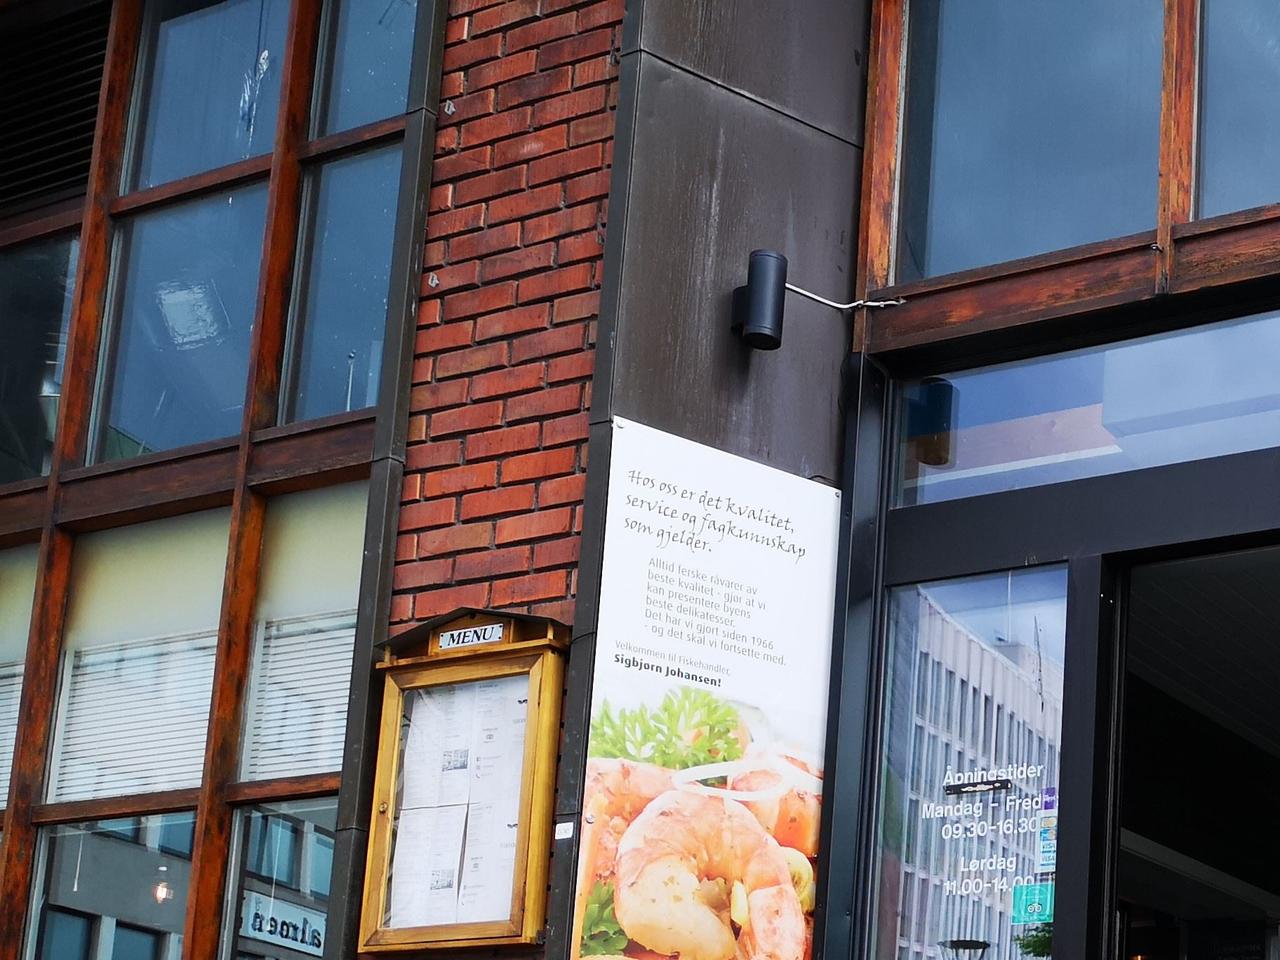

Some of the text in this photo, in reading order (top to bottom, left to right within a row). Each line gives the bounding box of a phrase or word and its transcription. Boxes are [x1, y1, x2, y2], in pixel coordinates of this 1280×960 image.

[628, 470, 794, 534] Hos oss er det kvalitet,
[624, 517, 712, 554] som gjelder.
[626, 494, 806, 565] service og fagkunnskap
[648, 570, 675, 586] beste
[678, 580, 714, 597] kvalitet
[758, 600, 766, 610] vi
[649, 558, 675, 573] Alltid
[746, 585, 758, 595] av
[646, 582, 752, 619] kan presentere byens
[646, 595, 673, 611] beste
[448, 627, 494, 646] MENU
[644, 608, 774, 650] Det har vi gjort siden 1966
[651, 624, 664, 637] og
[667, 628, 684, 640] det
[686, 632, 706, 646] skal
[708, 639, 717, 648] vi
[720, 640, 761, 659] fortsette
[762, 652, 786, 666] med.
[615, 640, 666, 660] Velkommen
[664, 666, 722, 688] Johansen!
[922, 801, 984, 819] Mandag
[942, 816, 1038, 840] 09.30-16.30
[960, 854, 1017, 872] Lørdag
